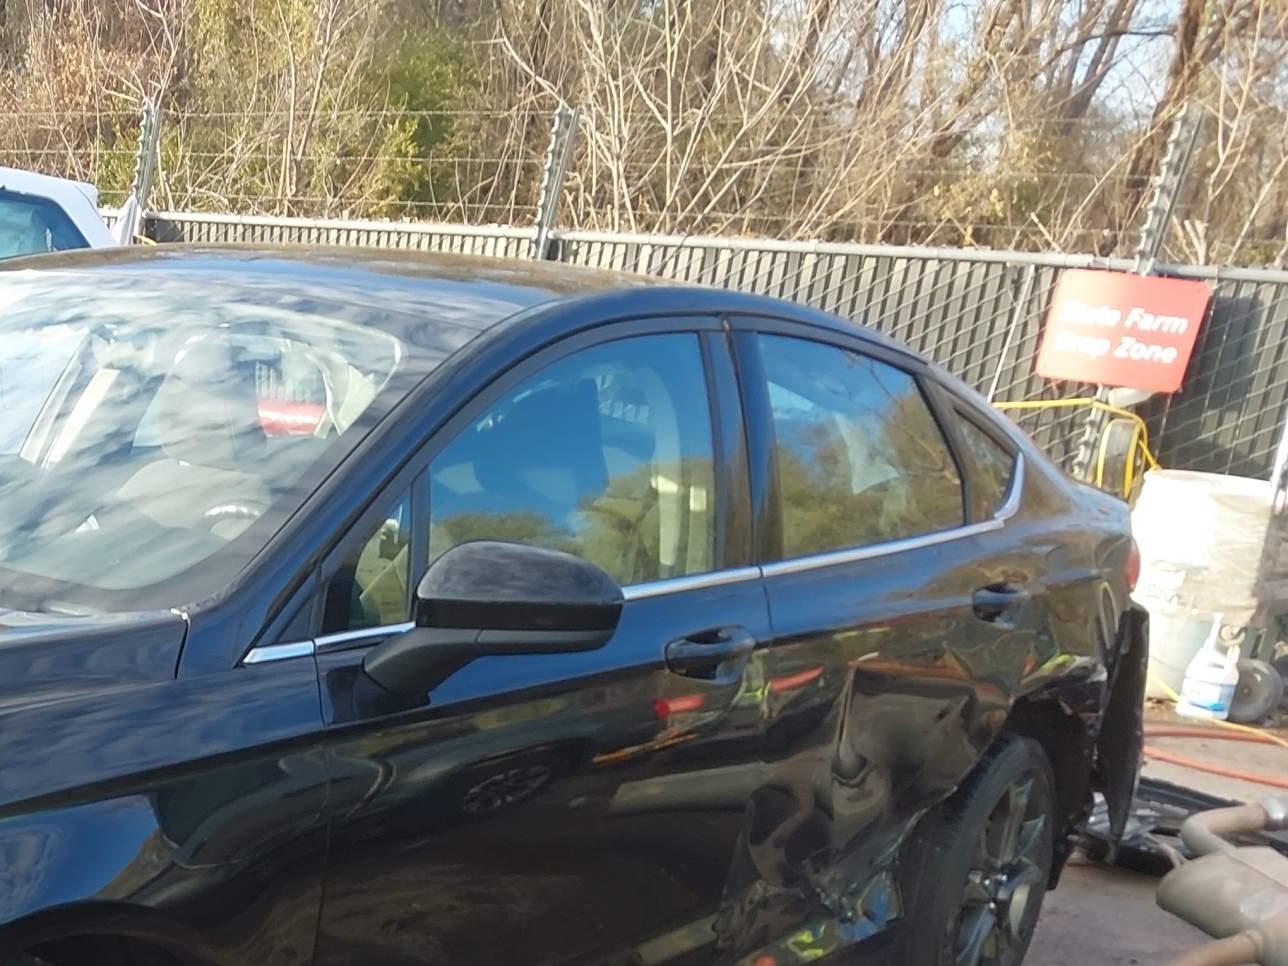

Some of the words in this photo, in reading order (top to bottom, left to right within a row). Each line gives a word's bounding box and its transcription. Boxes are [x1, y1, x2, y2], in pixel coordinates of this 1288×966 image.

[1059, 300, 1121, 328] tate
[1124, 307, 1188, 334] Farm
[1113, 336, 1178, 364] Zone
